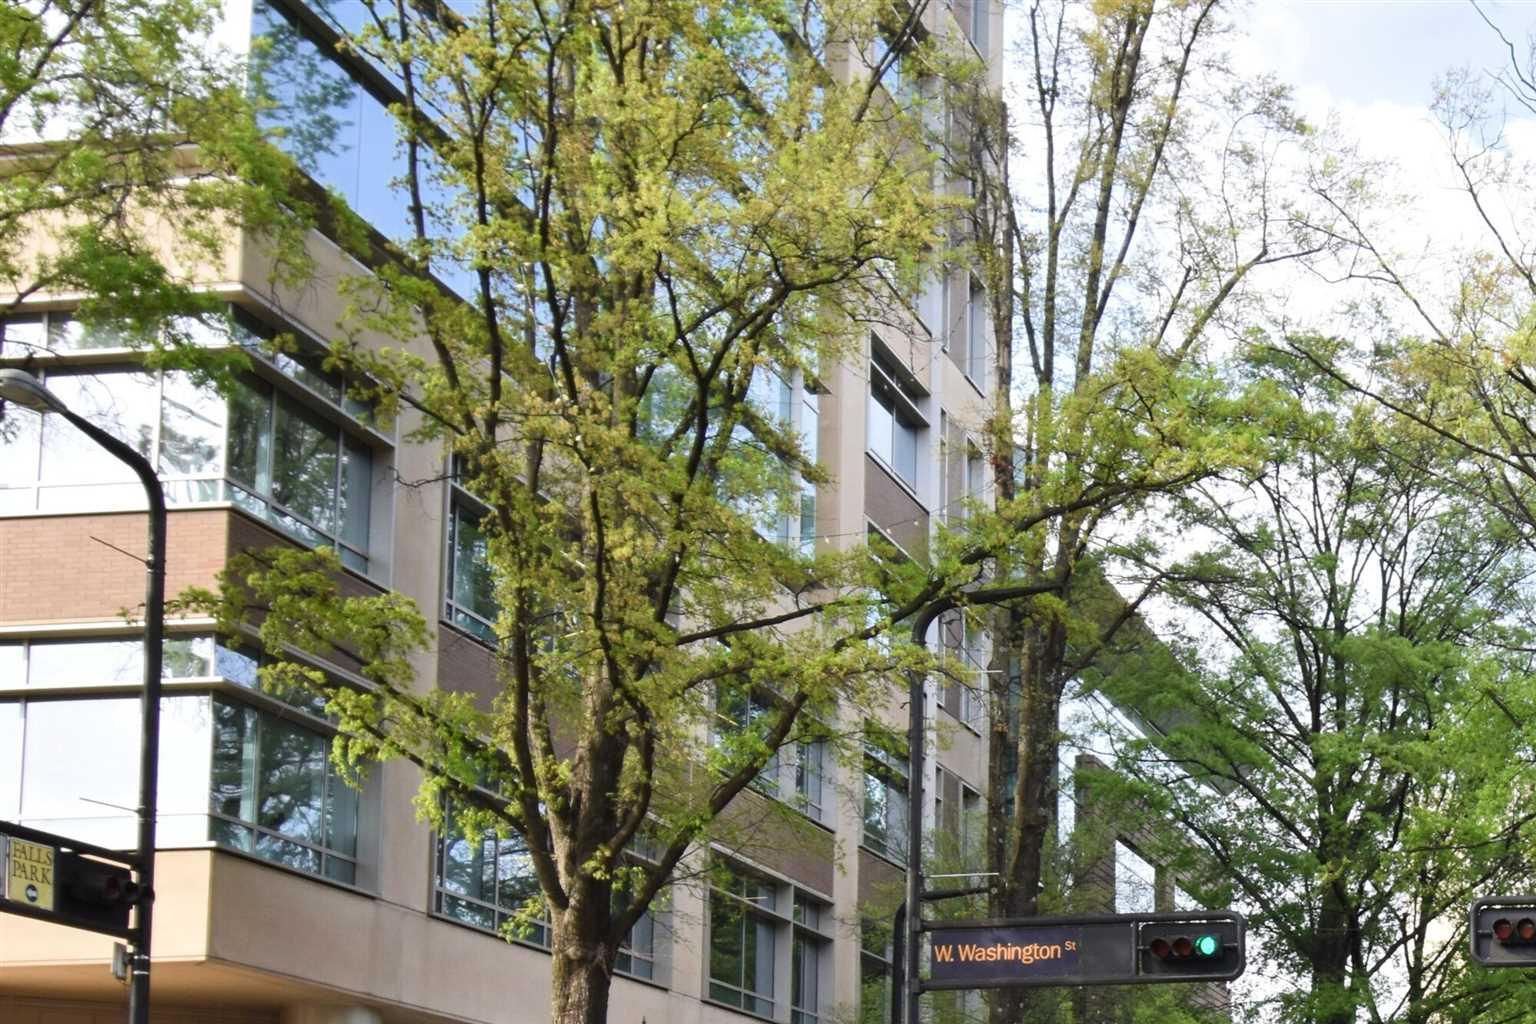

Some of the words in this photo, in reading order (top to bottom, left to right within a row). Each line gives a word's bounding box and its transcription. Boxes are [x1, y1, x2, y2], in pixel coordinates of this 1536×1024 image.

[13, 841, 53, 867] FALLS
[12, 860, 52, 885] PARK
[935, 944, 954, 963] W.
[958, 943, 1061, 965] Washington
[1064, 940, 1077, 951] St
